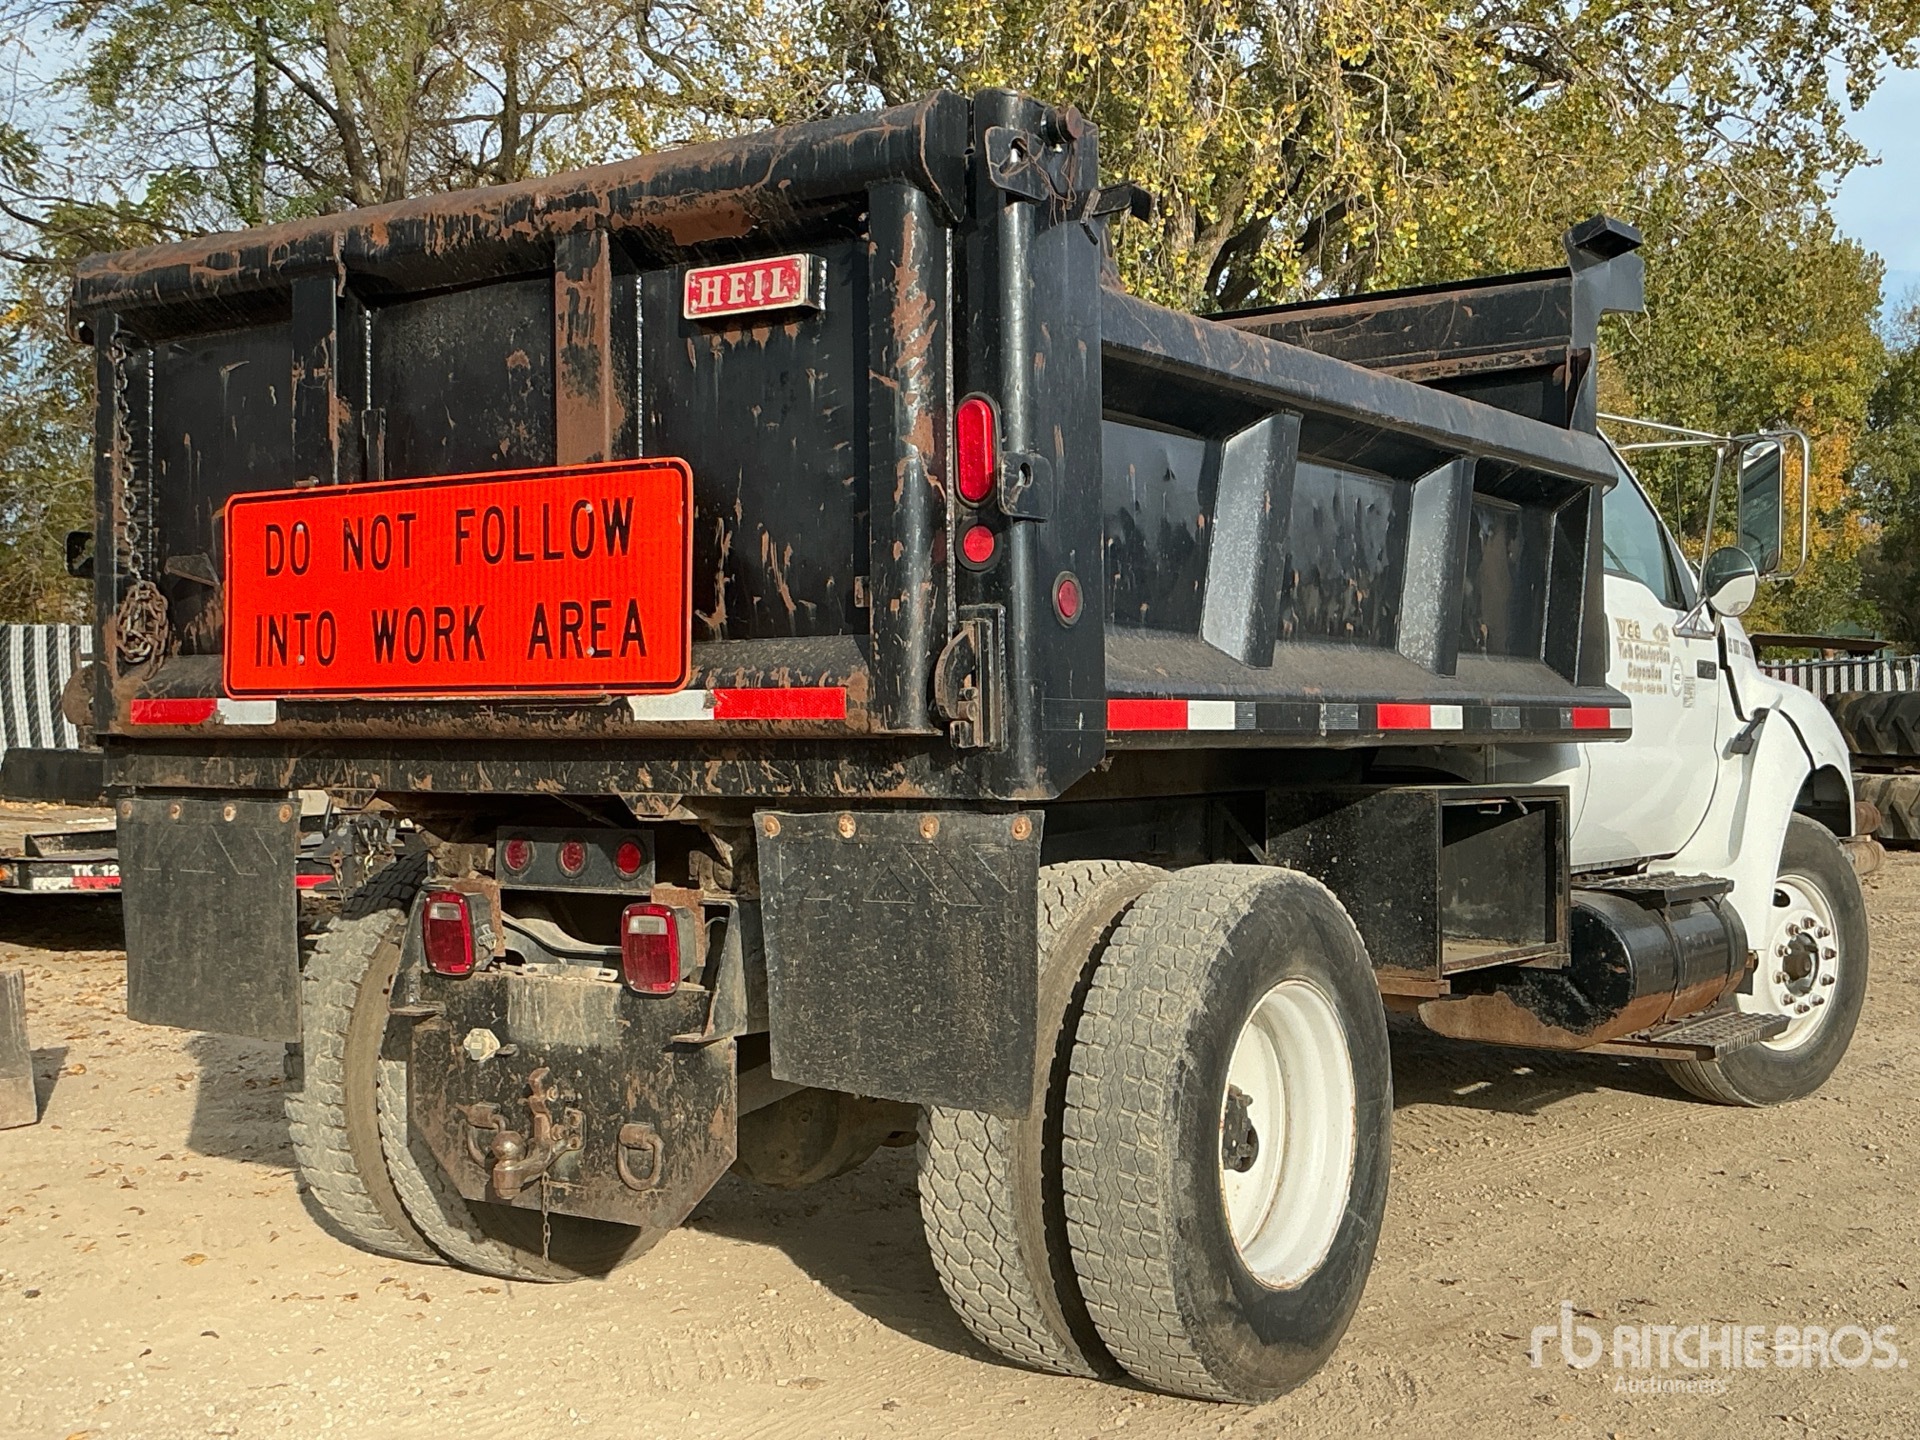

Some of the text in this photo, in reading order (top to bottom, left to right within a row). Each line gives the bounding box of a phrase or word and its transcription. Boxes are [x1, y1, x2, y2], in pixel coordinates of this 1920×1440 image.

[699, 267, 790, 307] HEIL
[265, 497, 634, 576] DO NOT FOLLOW
[255, 598, 647, 666] INTO WORK AREA
[71, 864, 120, 877] TK 12
